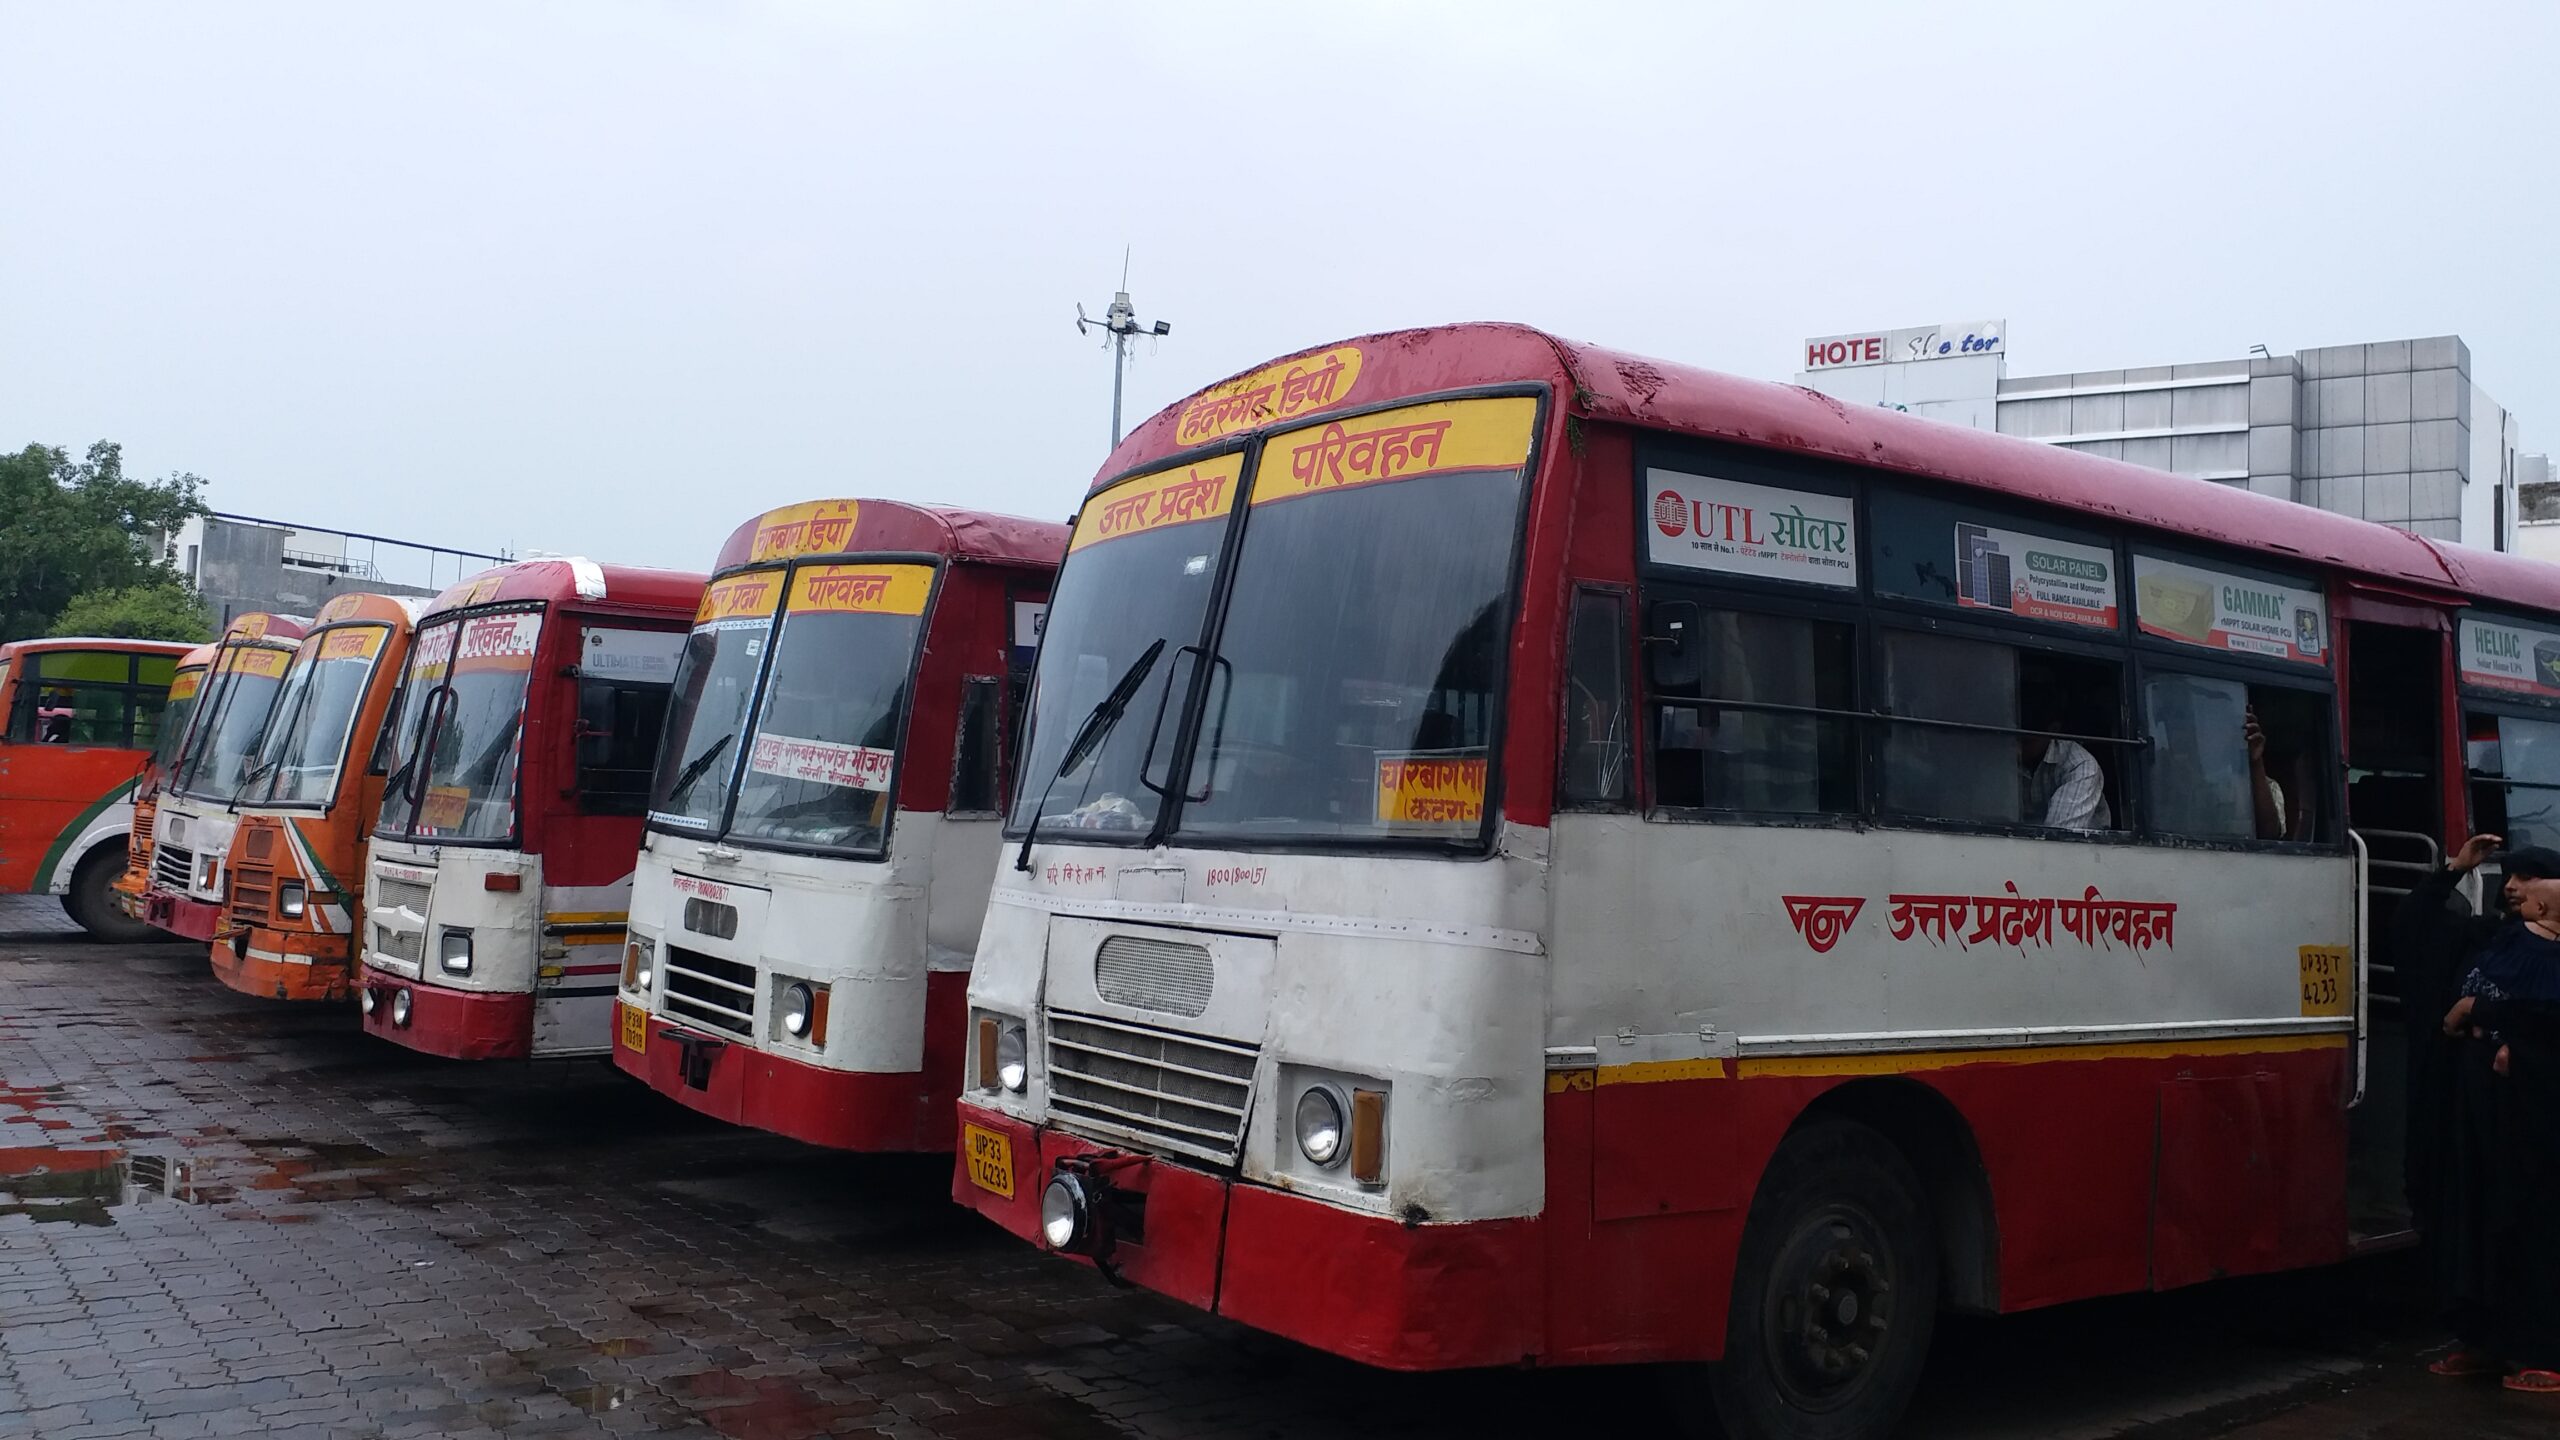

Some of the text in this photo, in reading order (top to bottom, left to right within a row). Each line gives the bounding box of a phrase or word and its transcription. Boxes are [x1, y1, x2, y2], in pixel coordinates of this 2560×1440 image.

[1278, 354, 1345, 415] डिपो
[1291, 422, 1452, 487] परिवहन
[1099, 468, 1227, 534] उत्तर प्रदेश
[1690, 500, 1847, 554] UTL सोलर
[1691, 541, 1699, 550] 10
[1837, 559, 1849, 569] PCU
[2032, 555, 2102, 577] SOLAR PANEL
[808, 565, 892, 609] परिवहन
[2036, 590, 2101, 609] FULL RANGE AVAILABLE
[2474, 626, 2521, 660] HELIAC
[1885, 880, 2177, 966] उत्तर प्रदेश परिवहन
[2303, 978, 2337, 1006] 4233
[975, 1132, 1001, 1162] UP33
[975, 1158, 1008, 1190] T4233
